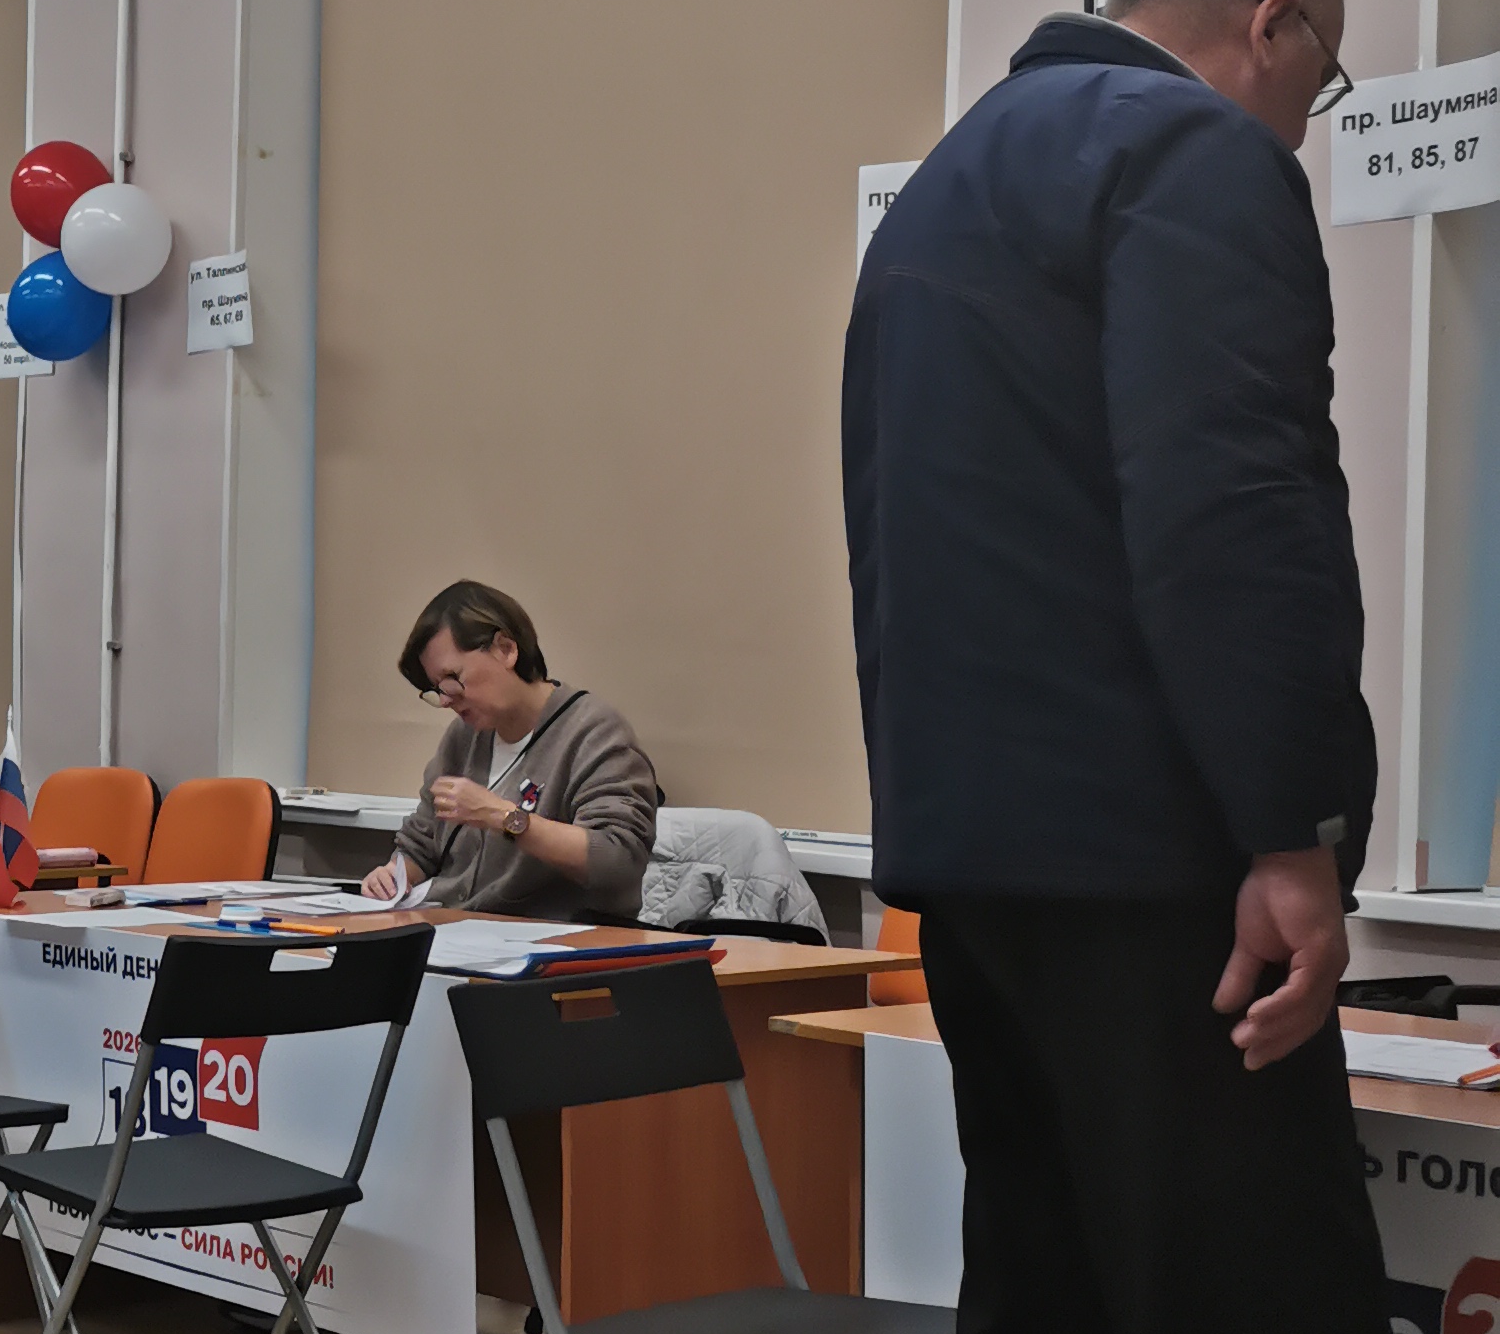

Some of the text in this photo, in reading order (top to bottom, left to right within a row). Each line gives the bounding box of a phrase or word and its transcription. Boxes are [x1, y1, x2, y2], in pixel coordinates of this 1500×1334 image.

[1341, 112, 1382, 135] пр.
[1367, 136, 1480, 176] 81, 85, 87
[41, 943, 160, 980] ЕДИНЫЙ ДЕН
[154, 1066, 195, 1120] 19
[203, 1049, 254, 1107] 20
[181, 1227, 235, 1263] СИЛА
